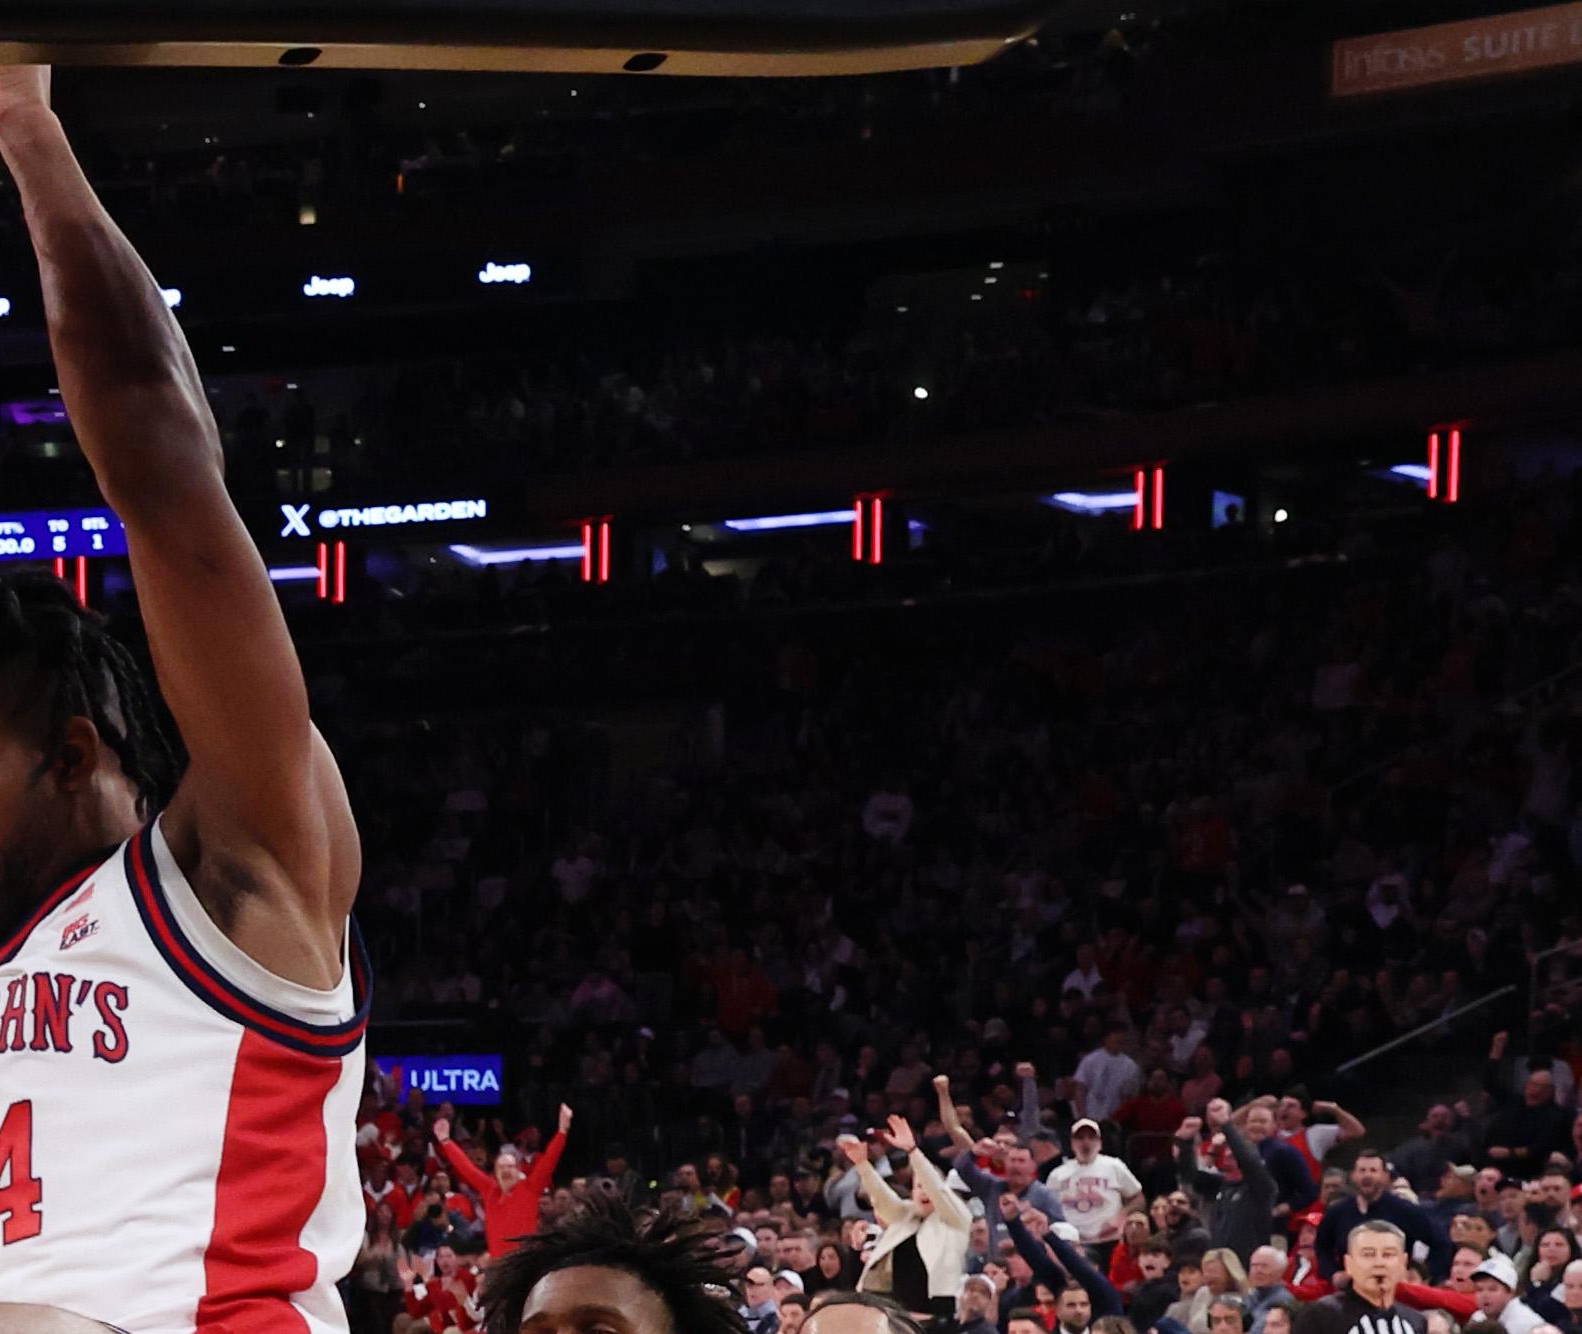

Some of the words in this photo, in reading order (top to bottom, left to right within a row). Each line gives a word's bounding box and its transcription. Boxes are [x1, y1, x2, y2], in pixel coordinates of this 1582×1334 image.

[1463, 23, 1559, 63] SUITE
[479, 262, 531, 284] Jeep
[303, 276, 354, 297] Jeep
[319, 500, 486, 528] @THEGARDEN
[48, 519, 68, 533] TO
[53, 536, 66, 552] 5
[92, 534, 103, 549] 1
[60, 920, 101, 951] EAST
[61, 913, 91, 940] BIG
[410, 1069, 500, 1091] ULTRA
